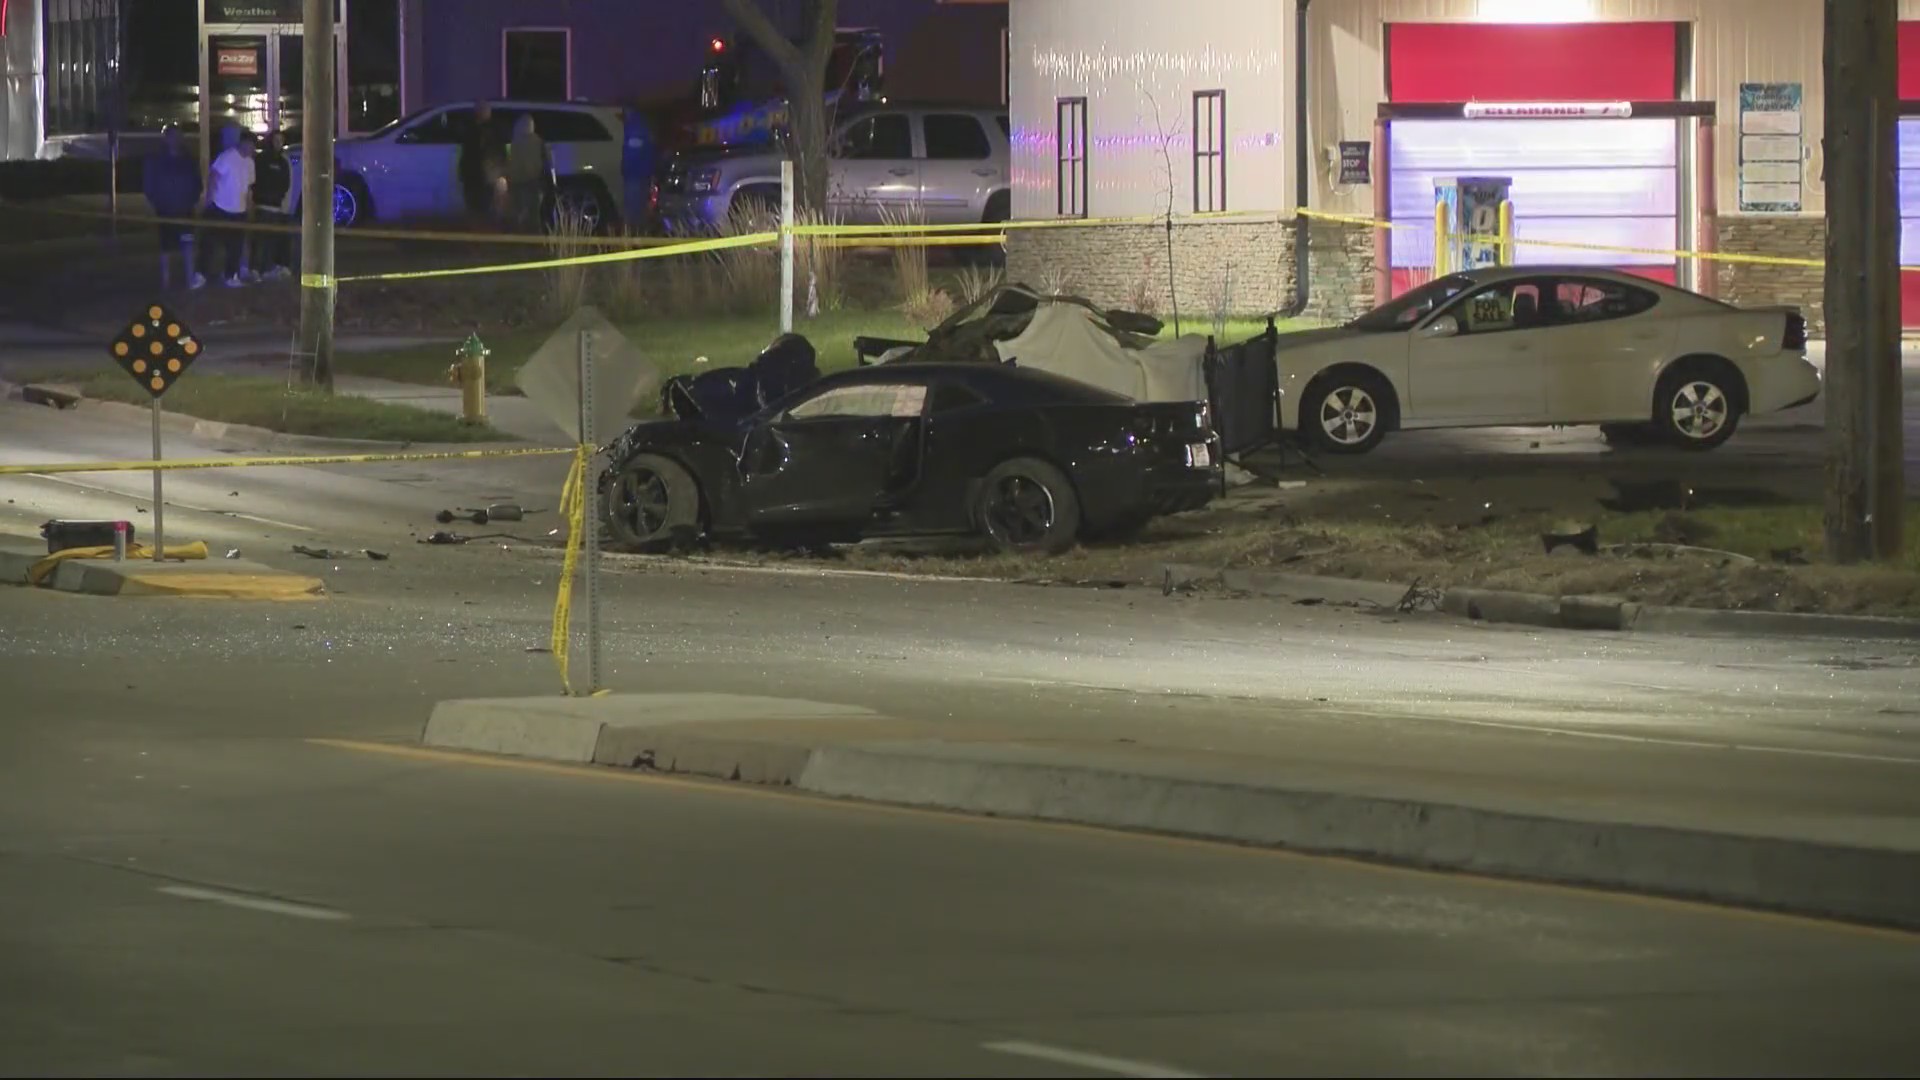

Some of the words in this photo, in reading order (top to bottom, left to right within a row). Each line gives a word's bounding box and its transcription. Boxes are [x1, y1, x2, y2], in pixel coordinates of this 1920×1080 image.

[223, 7, 277, 16] Weather
[1343, 159, 1360, 168] STOP
[1474, 300, 1500, 312] FOR
[1473, 311, 1506, 322] SALE
